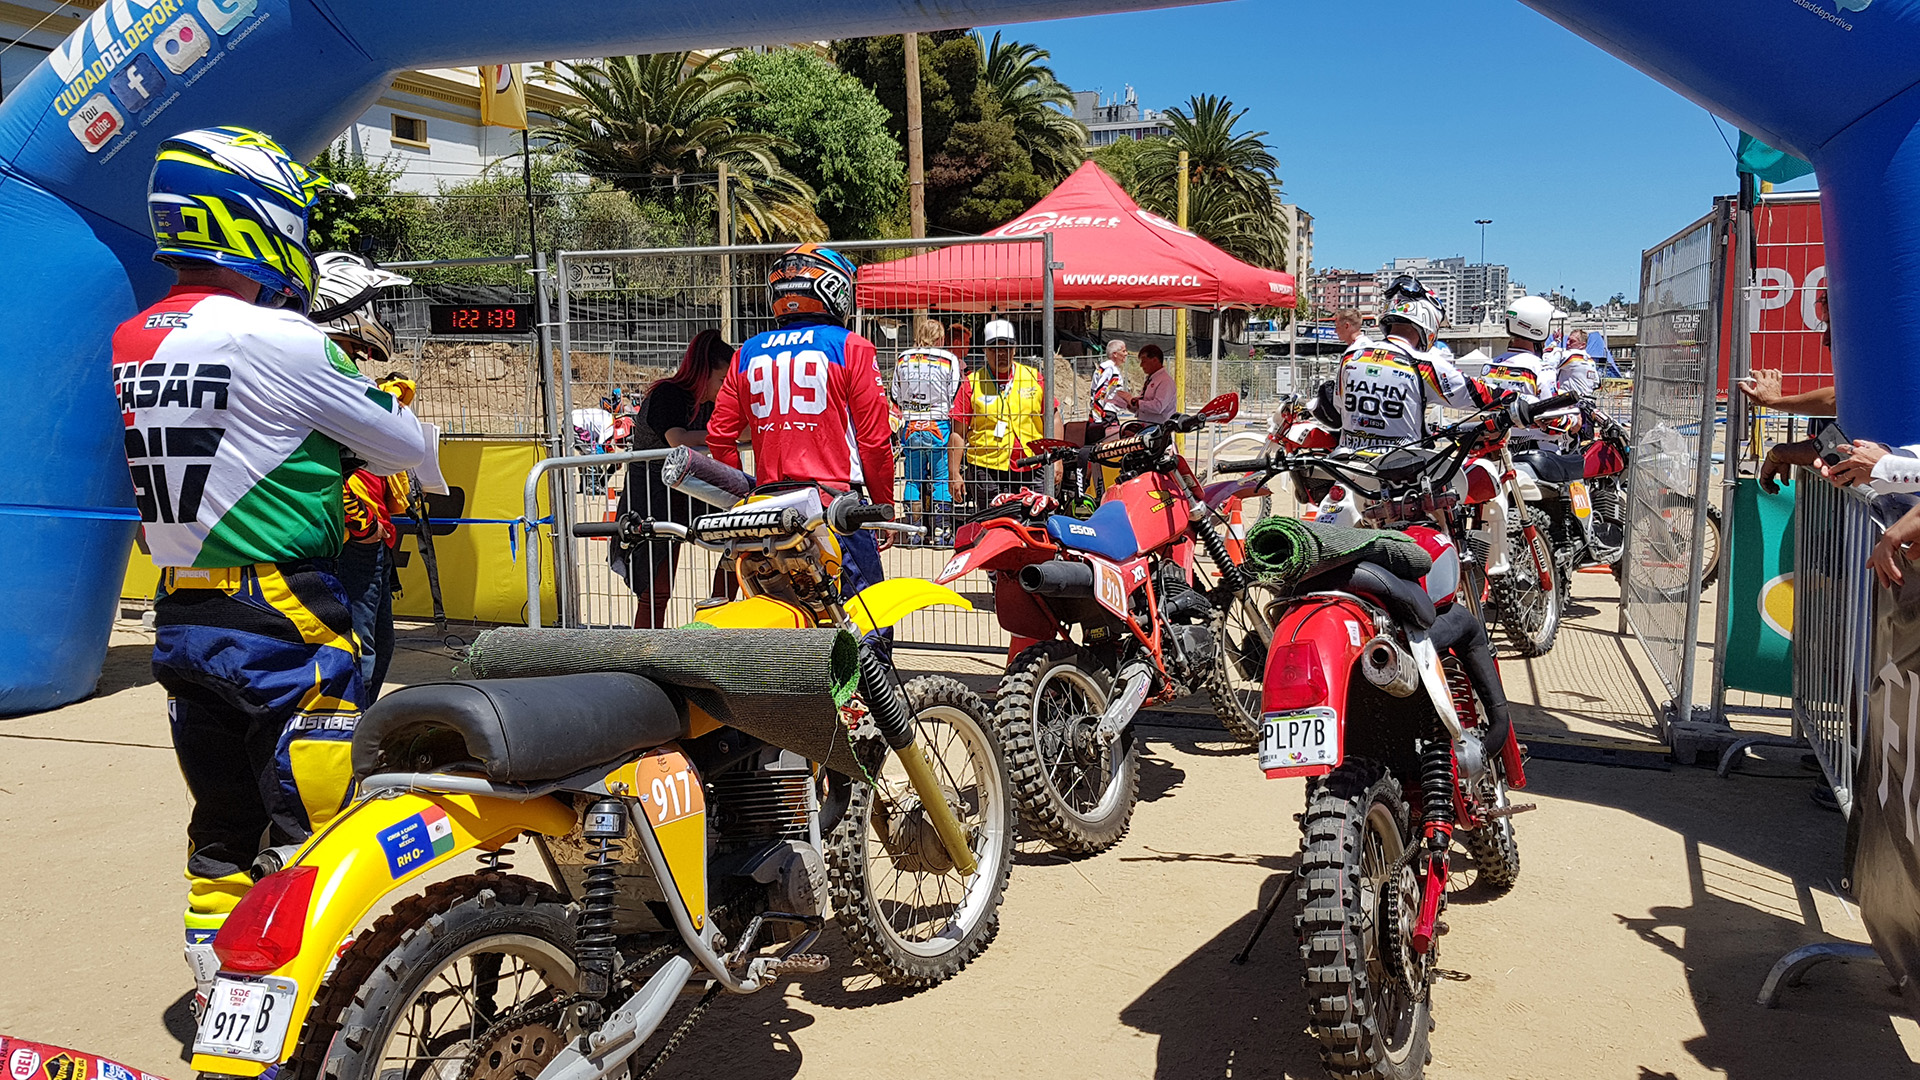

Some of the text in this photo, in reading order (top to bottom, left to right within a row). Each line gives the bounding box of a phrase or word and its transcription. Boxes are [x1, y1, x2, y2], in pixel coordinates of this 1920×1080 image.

[79, 105, 99, 124] You
[87, 117, 111, 140] Tube
[1062, 274, 1201, 287] WWW.PROKART.CL
[761, 329, 814, 349] JARA
[747, 350, 829, 419] 919
[1076, 467, 1084, 498] THOR
[697, 512, 780, 530] RENTHAL
[701, 527, 786, 541] RENTHAL
[1131, 565, 1147, 584] XR
[1106, 578, 1120, 607] 919
[1264, 719, 1325, 751] PLP7B
[651, 770, 691, 822] 917
[397, 852, 413, 868] RH
[212, 1011, 250, 1041] 917
